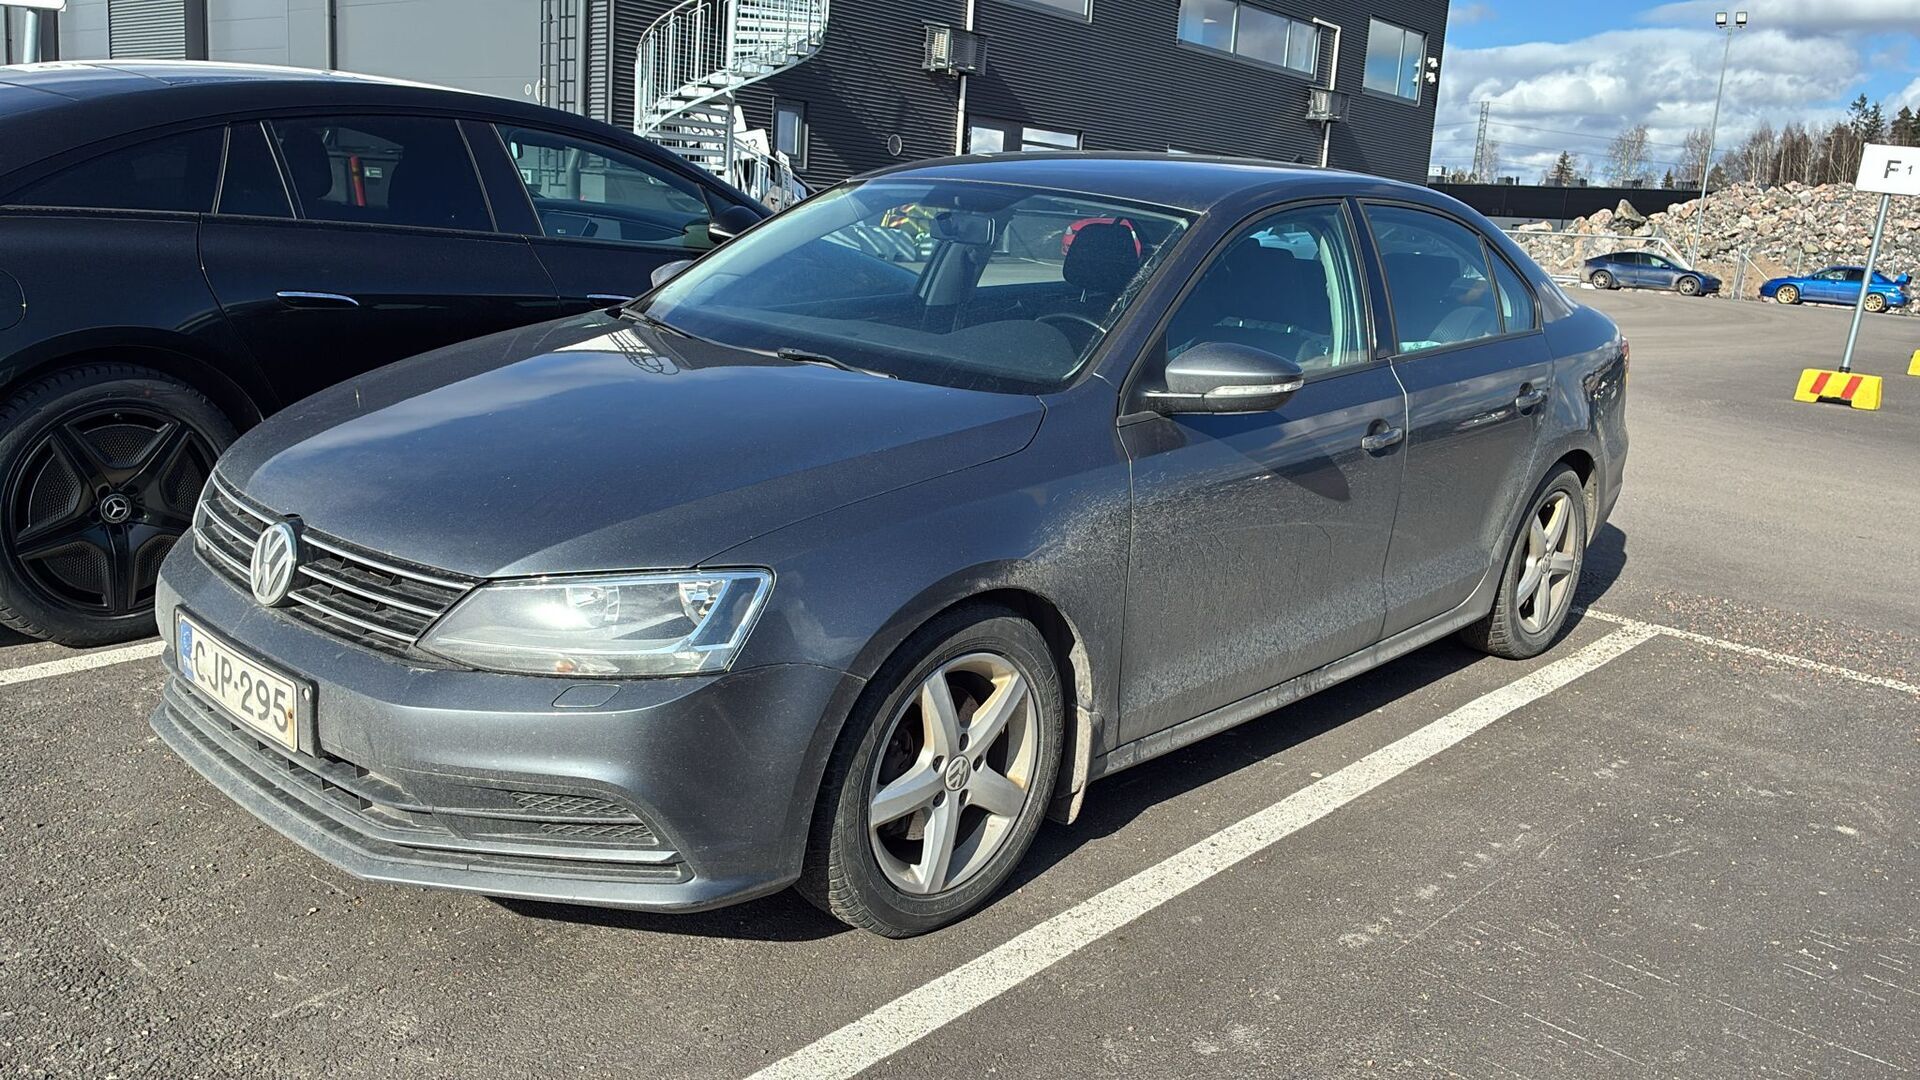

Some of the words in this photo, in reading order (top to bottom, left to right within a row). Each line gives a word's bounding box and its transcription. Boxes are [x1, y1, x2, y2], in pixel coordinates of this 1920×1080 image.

[1883, 159, 1902, 179] F
[252, 523, 295, 606] VW
[195, 640, 288, 733] CJP-295
